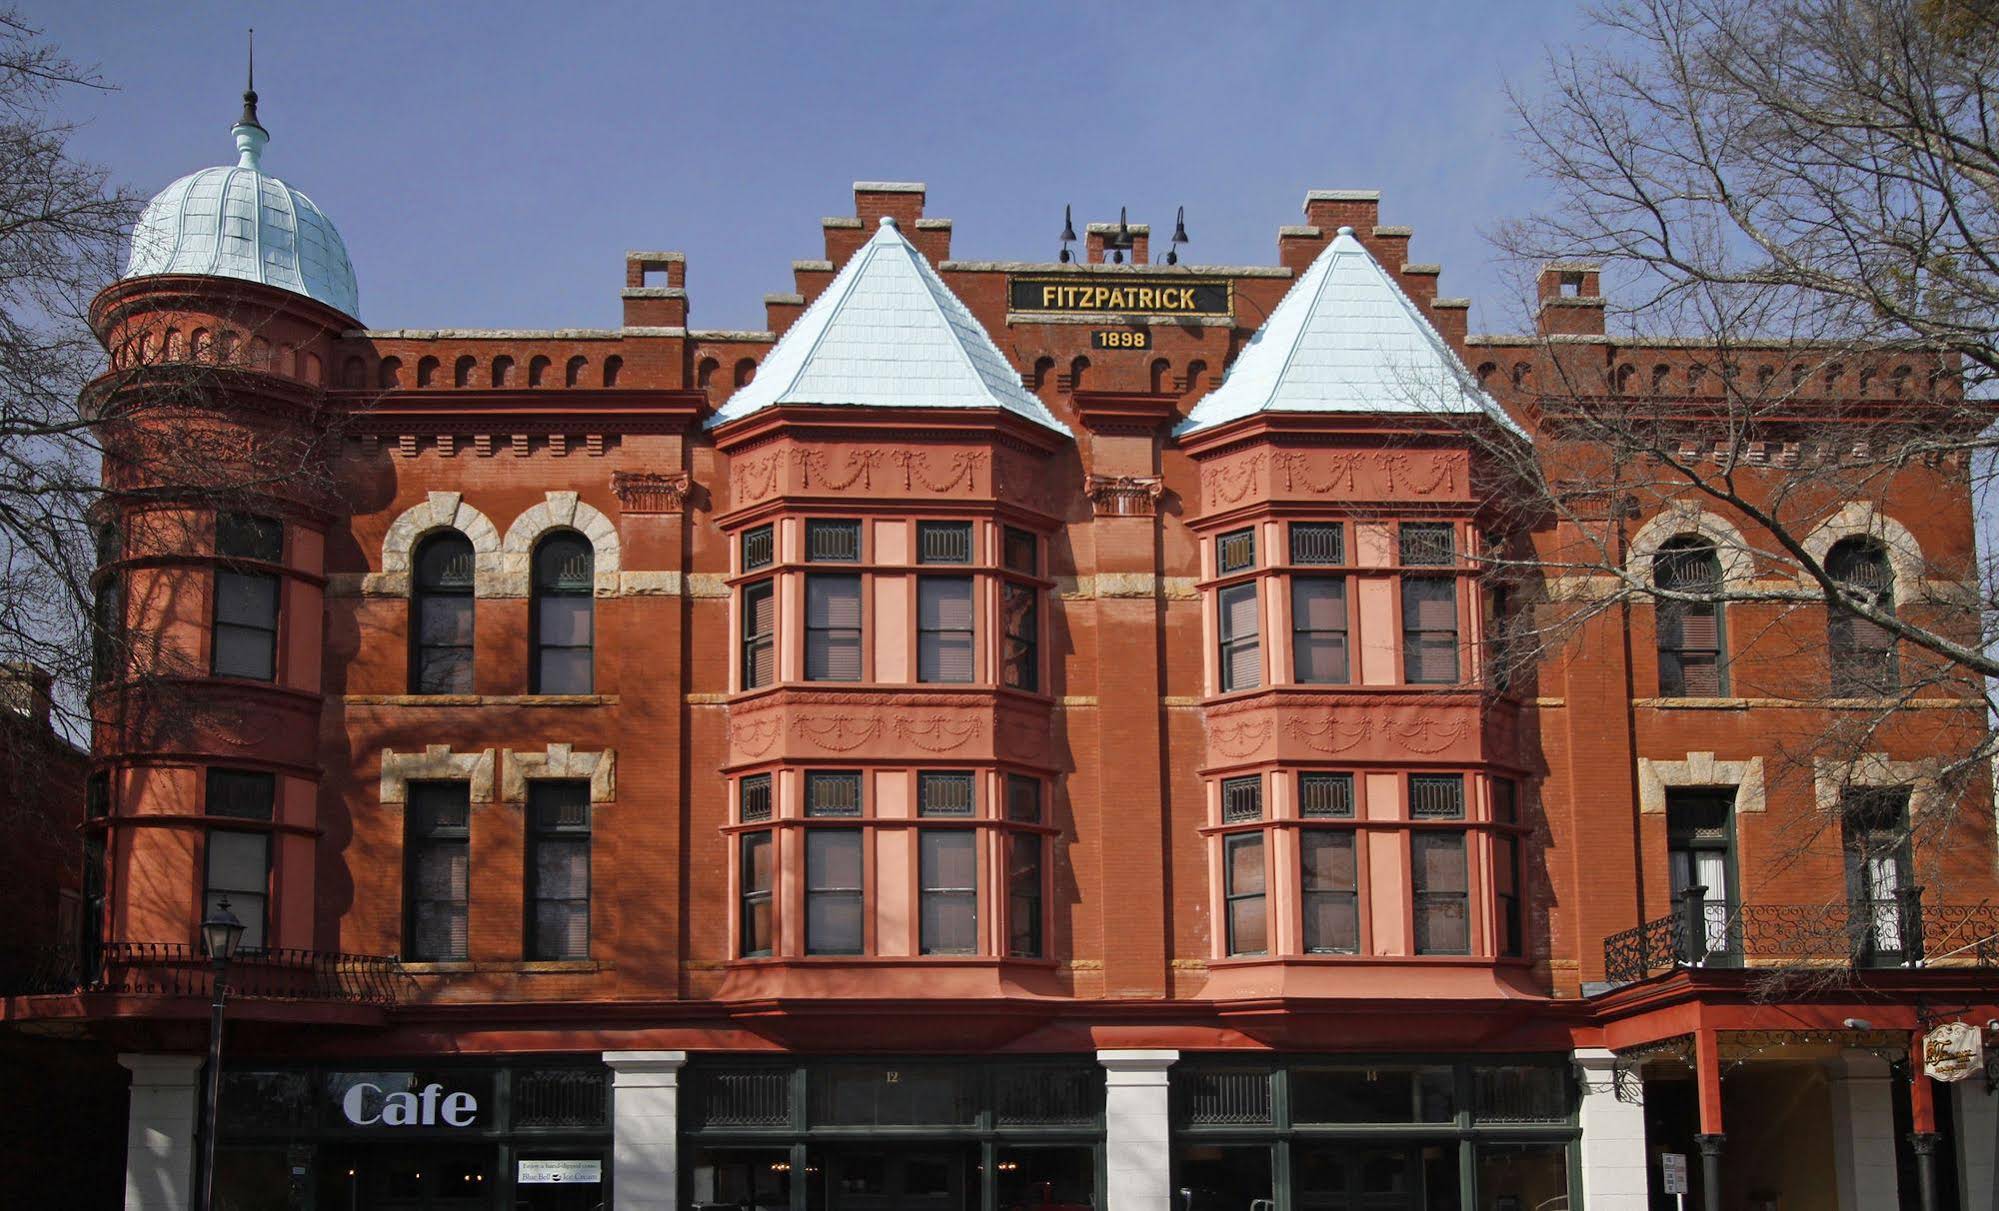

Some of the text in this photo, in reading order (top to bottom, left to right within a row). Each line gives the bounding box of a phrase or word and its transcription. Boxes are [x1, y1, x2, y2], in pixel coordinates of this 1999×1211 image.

[1042, 286, 1196, 310] FITZPATRICK
[1099, 331, 1145, 347] 1898
[343, 1082, 478, 1127] Cafe
[522, 1172, 538, 1180] Blue
[538, 1172, 551, 1180] Bell
[574, 1172, 598, 1180] Cream
